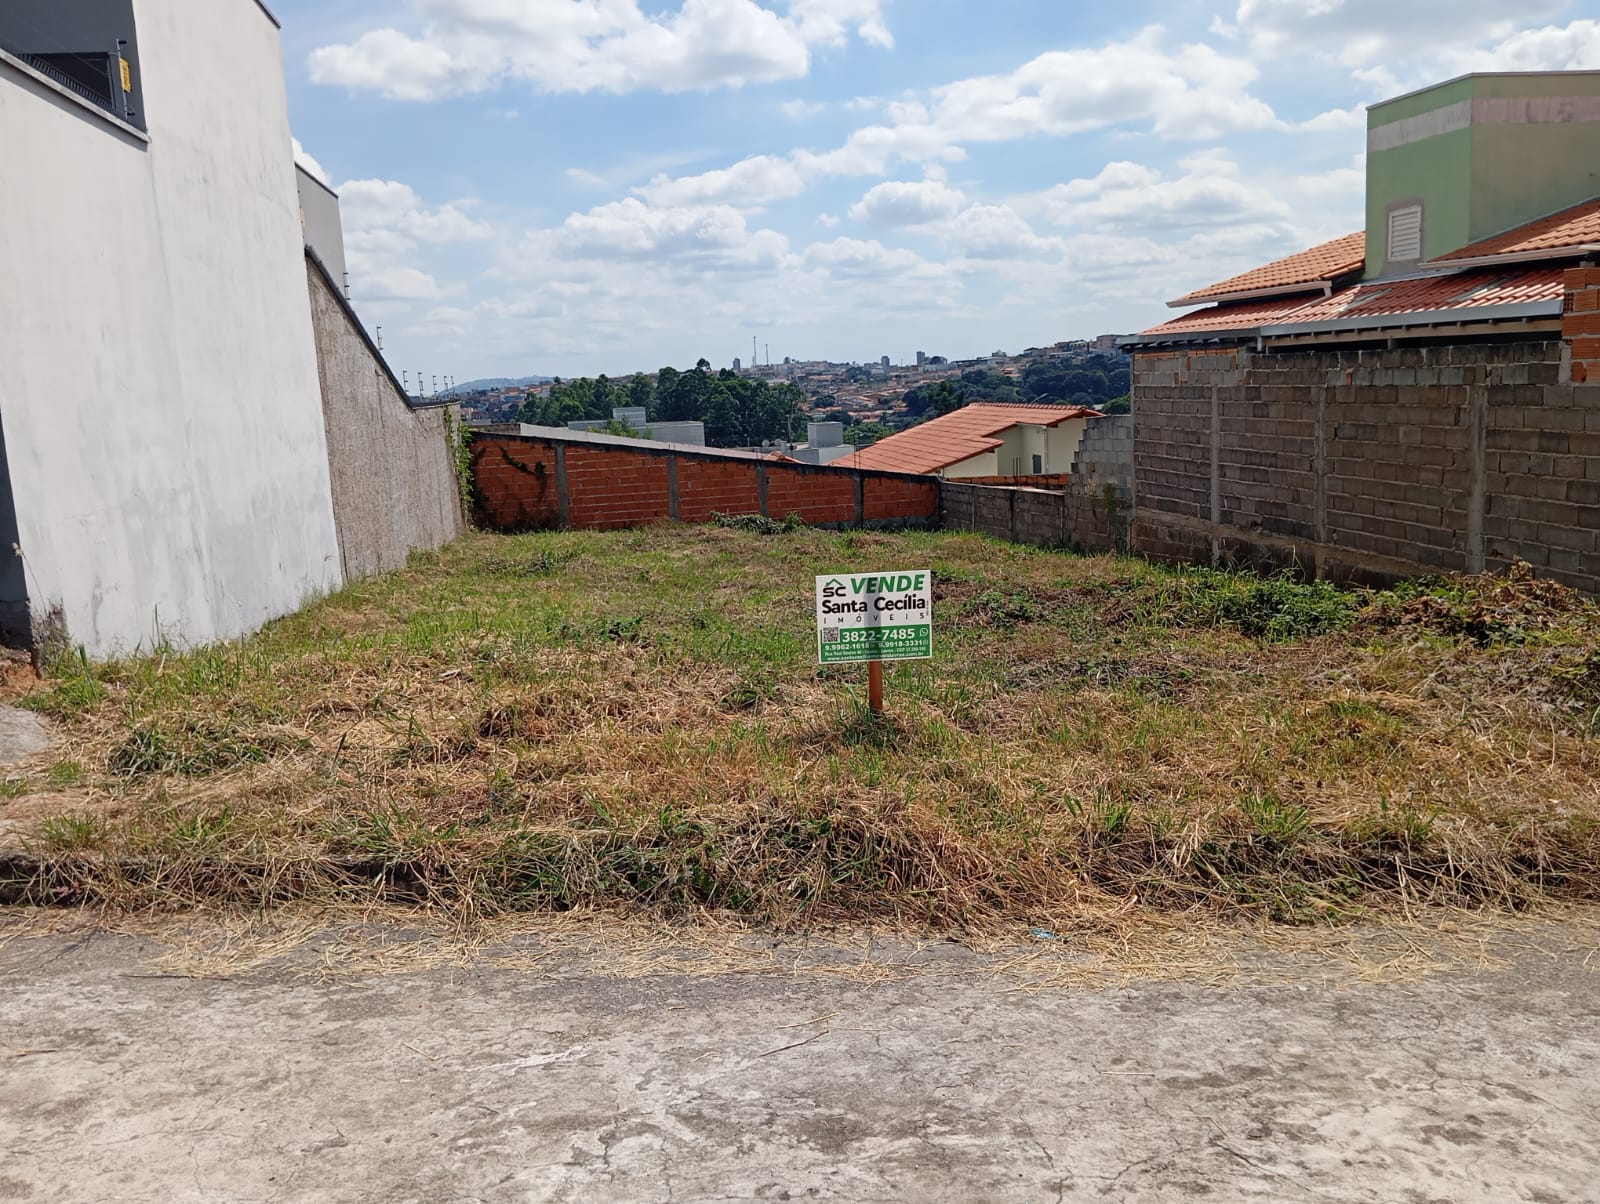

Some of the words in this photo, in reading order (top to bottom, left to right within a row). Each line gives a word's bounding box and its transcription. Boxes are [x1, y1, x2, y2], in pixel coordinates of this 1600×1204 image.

[823, 587, 846, 597] SC
[850, 574, 926, 594] VENDE
[822, 600, 868, 614] Santa
[874, 594, 925, 611] Cecília
[842, 628, 915, 642] 3822-7485
